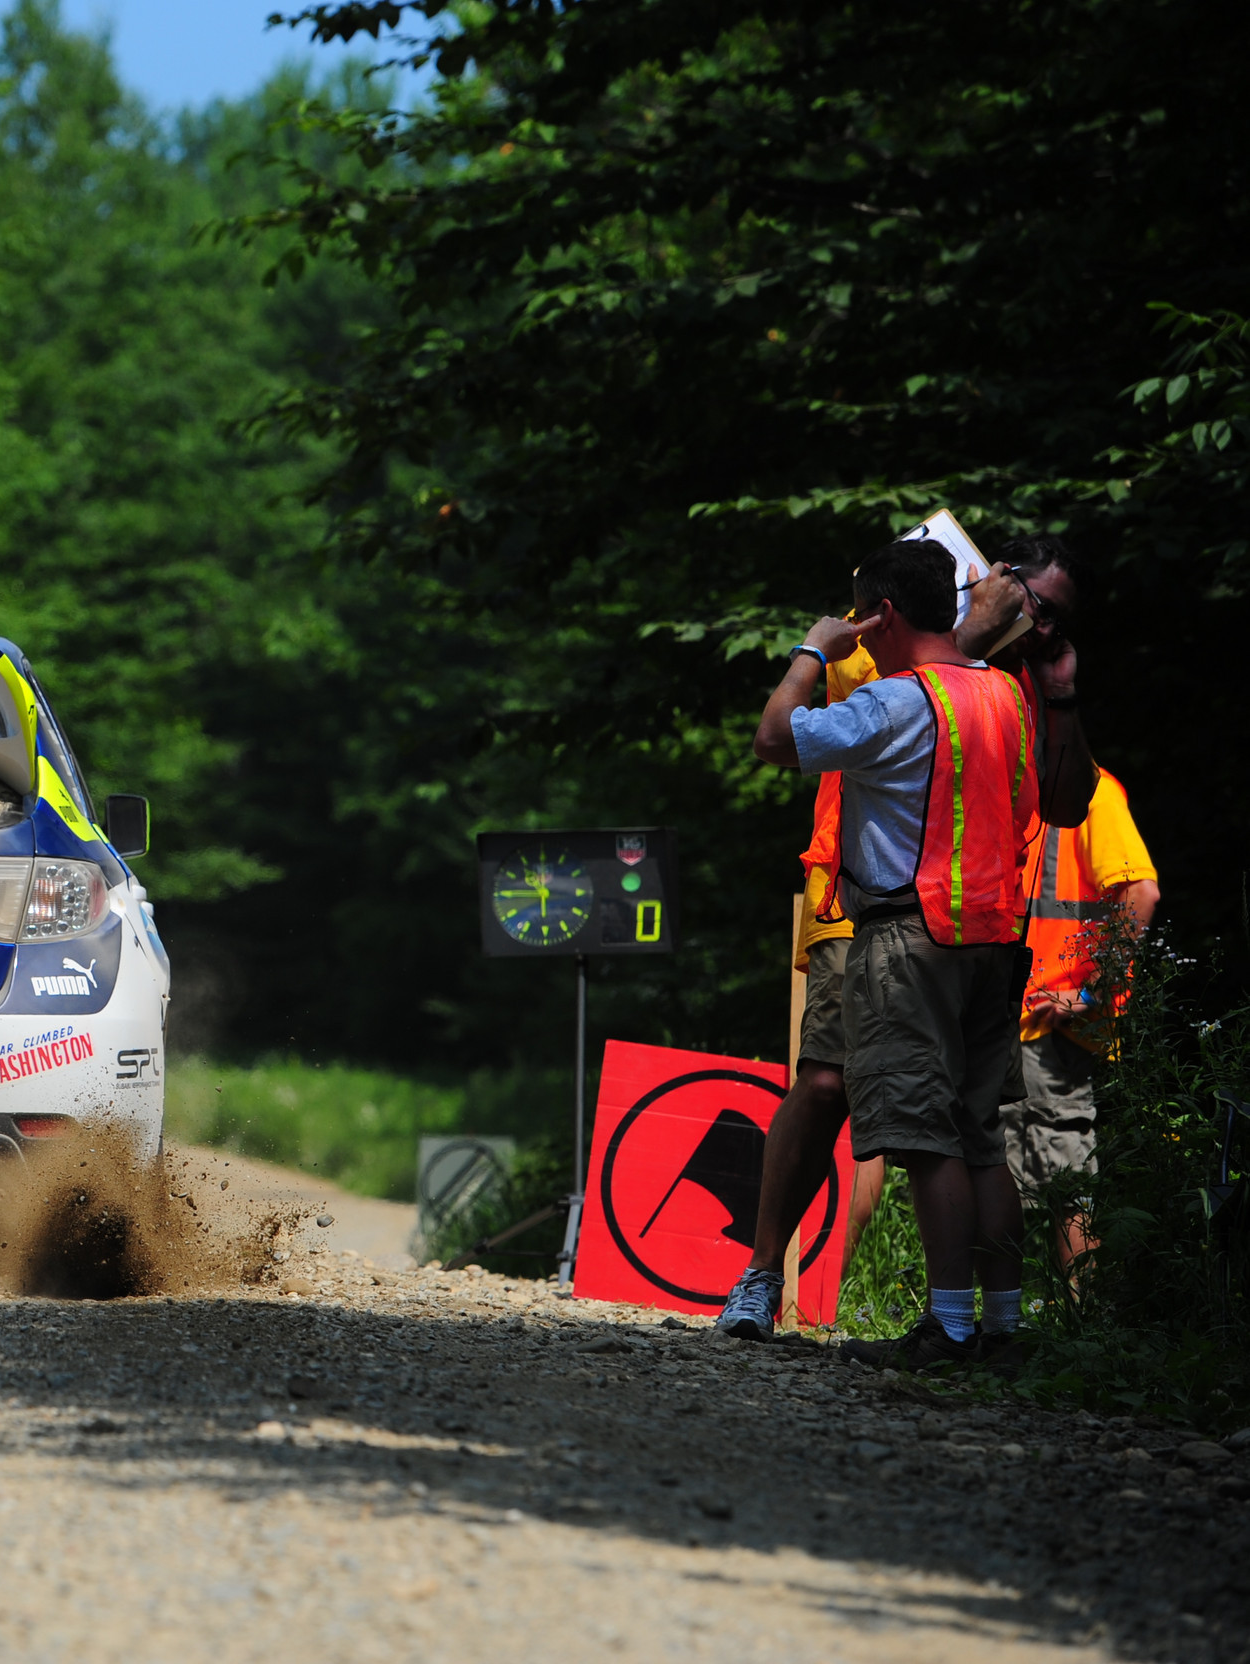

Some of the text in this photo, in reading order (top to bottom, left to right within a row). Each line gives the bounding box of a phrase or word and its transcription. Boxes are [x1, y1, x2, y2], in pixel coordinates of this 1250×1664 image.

[635, 899, 662, 942] 0
[31, 975, 90, 996] PUMA
[23, 1026, 73, 1048] CLIMBED
